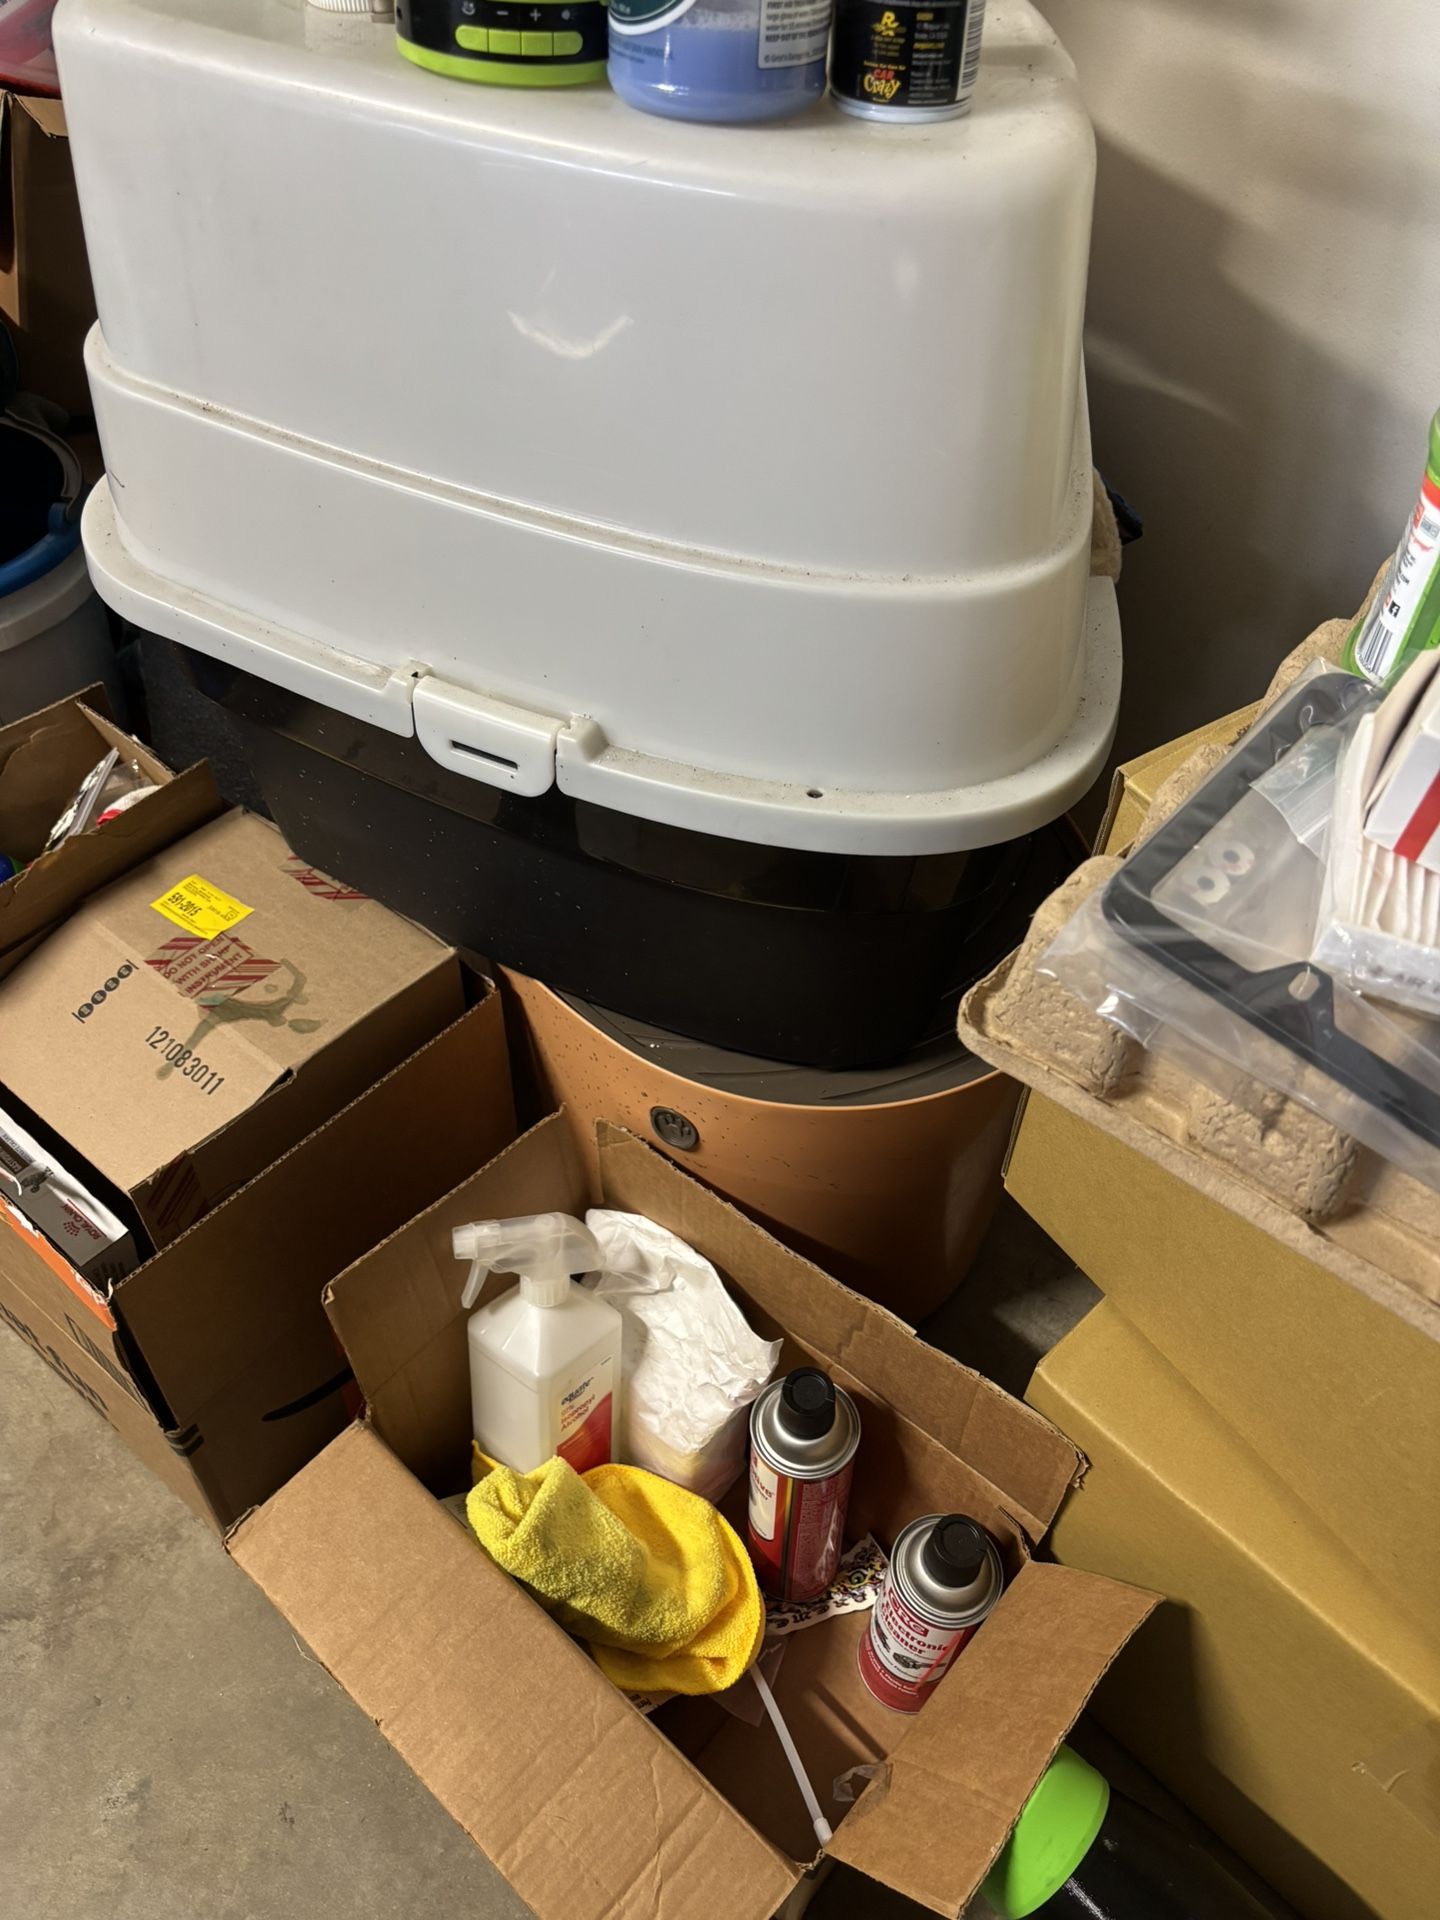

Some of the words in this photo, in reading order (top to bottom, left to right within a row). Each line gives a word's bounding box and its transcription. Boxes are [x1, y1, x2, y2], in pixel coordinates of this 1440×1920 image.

[863, 74, 901, 99] Crazy
[872, 69, 896, 81] CAR
[163, 967, 178, 979] DO
[178, 953, 197, 969] NOT
[174, 965, 200, 985] WITH
[185, 951, 243, 994] INSTRUMENT
[145, 1025, 225, 1096] 121083011
[79, 1220, 102, 1241] ROYAL
